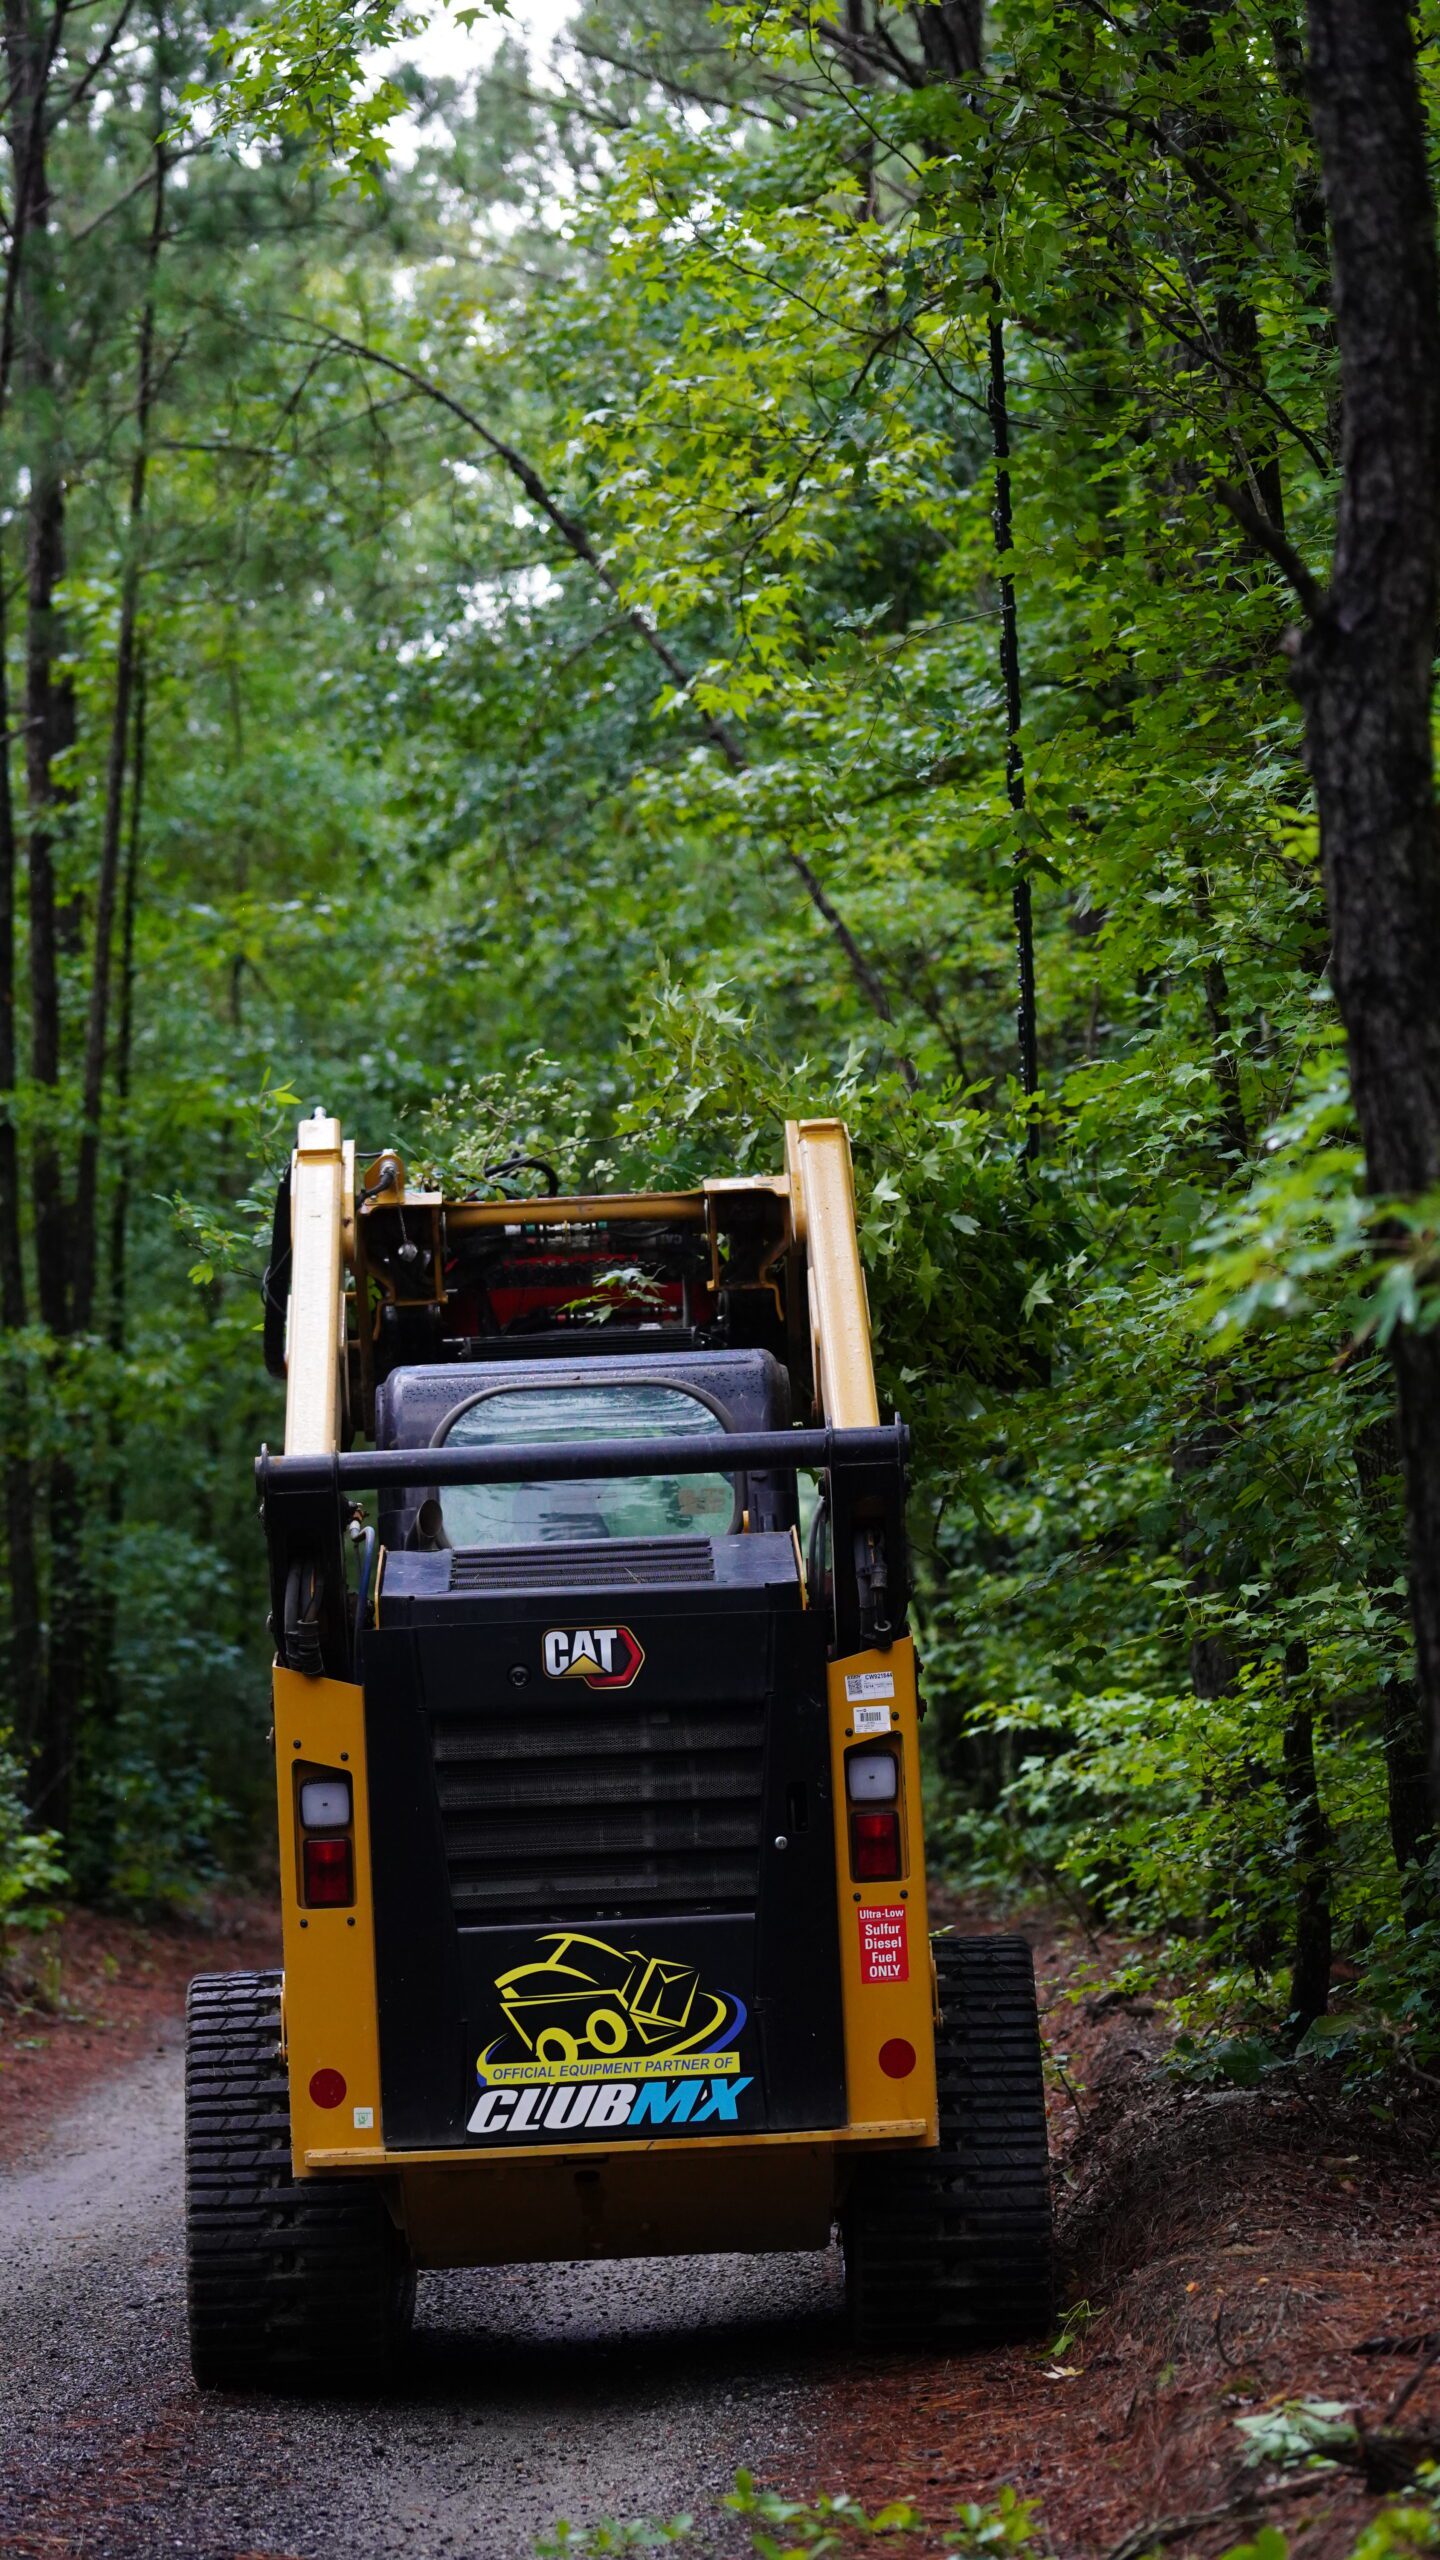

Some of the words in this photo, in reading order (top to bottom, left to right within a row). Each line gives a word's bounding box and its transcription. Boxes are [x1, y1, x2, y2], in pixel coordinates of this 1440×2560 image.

[544, 1629, 618, 1676] CAT
[859, 1908, 904, 1920] Ultra-Low
[865, 1923, 901, 1936] Sulfur
[865, 1936, 902, 1950] Diesel
[872, 1950, 897, 1964] Fuel
[869, 1964, 901, 1978] ONLY
[492, 2066, 555, 2080] OFFICIAL
[559, 2061, 642, 2077] EQUIPMENT
[645, 2058, 710, 2072] PARTNER
[713, 2056, 734, 2069] OF
[466, 2076, 755, 2134] CLUBMX
